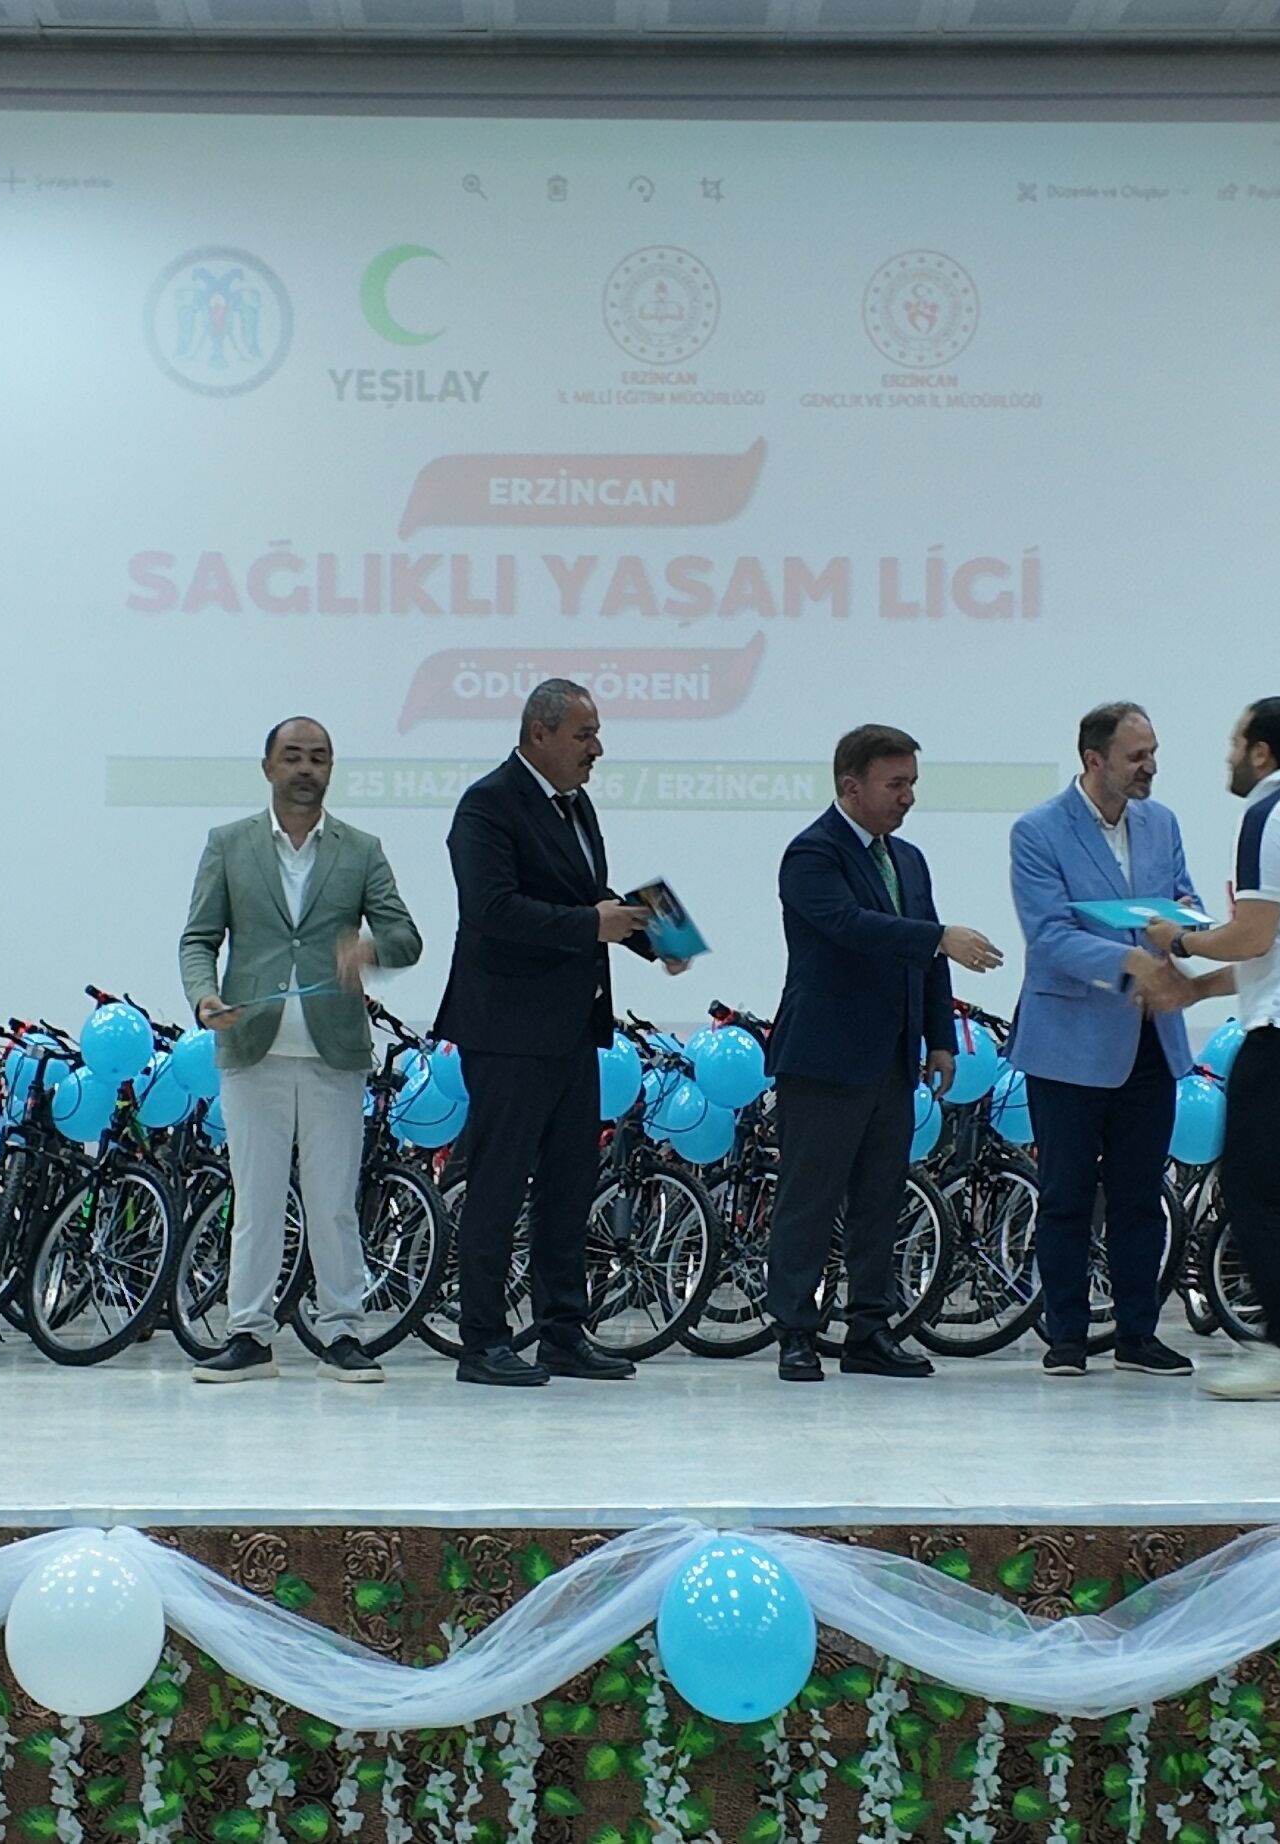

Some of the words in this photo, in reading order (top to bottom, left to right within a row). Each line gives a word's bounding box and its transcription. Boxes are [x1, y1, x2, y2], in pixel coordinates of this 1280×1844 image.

[488, 470, 677, 508] ERZİNCAN
[126, 538, 518, 617] SAĞLIKLI
[541, 554, 852, 630] YAŞAM
[878, 544, 1044, 620] LİGİ
[451, 662, 555, 700] ÖDÜ
[347, 771, 385, 798] 25
[632, 772, 646, 805] /
[657, 767, 815, 802] ERZİNCAN
